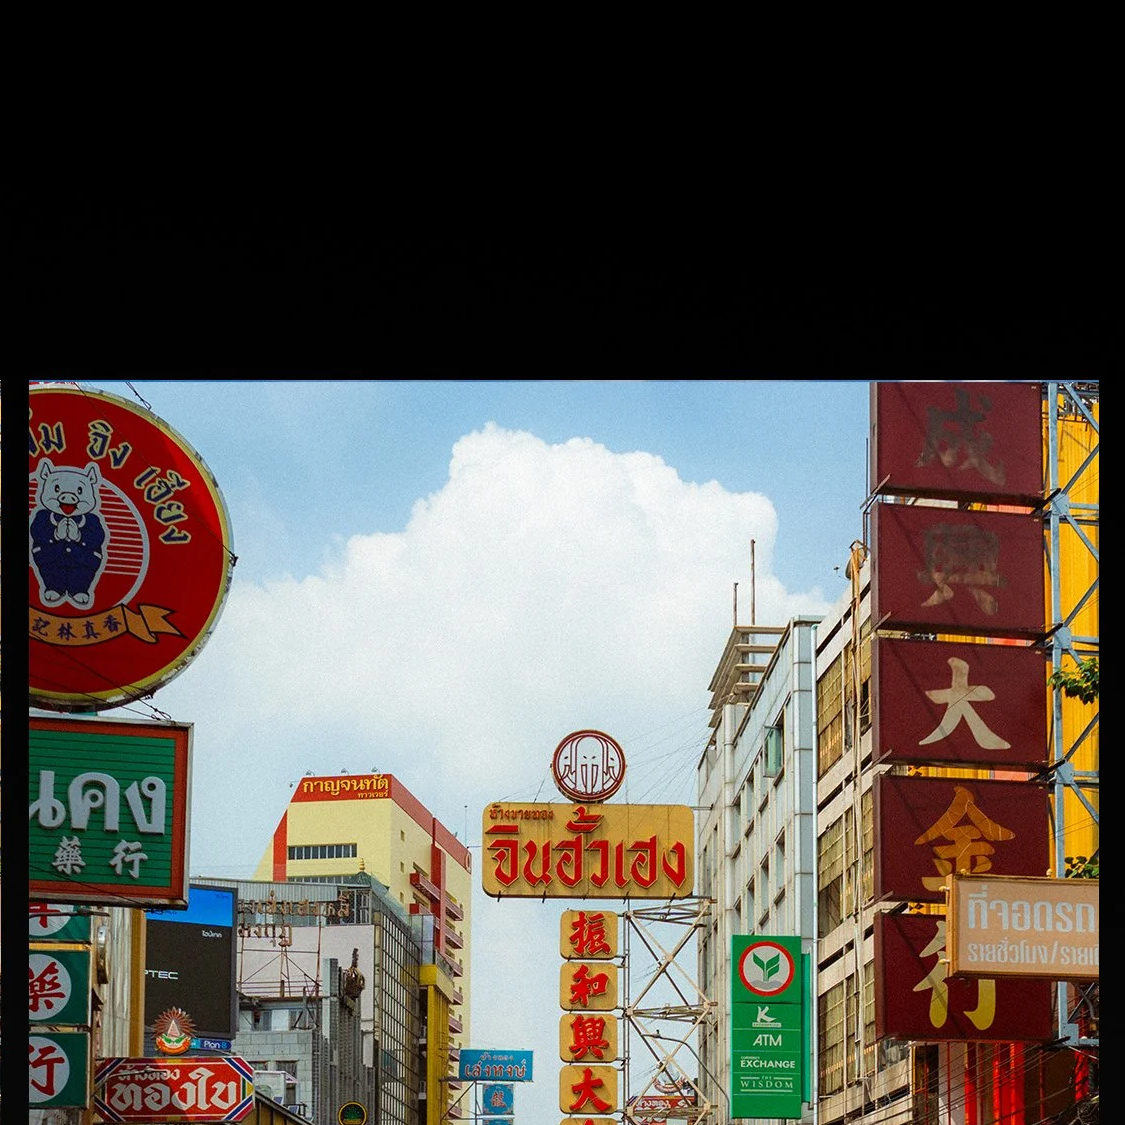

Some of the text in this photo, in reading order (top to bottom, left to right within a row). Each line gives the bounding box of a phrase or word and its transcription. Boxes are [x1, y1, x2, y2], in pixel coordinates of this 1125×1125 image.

[485, 805, 688, 889] จินฮั้วเฮง
[967, 884, 1095, 933] ที่จอดรถ
[967, 936, 1098, 965] รายชั่วโมง/รายเ
[752, 1034, 782, 1047] ATM
[740, 1059, 796, 1069] EXCHANGE
[740, 1080, 794, 1088] WISDOM
